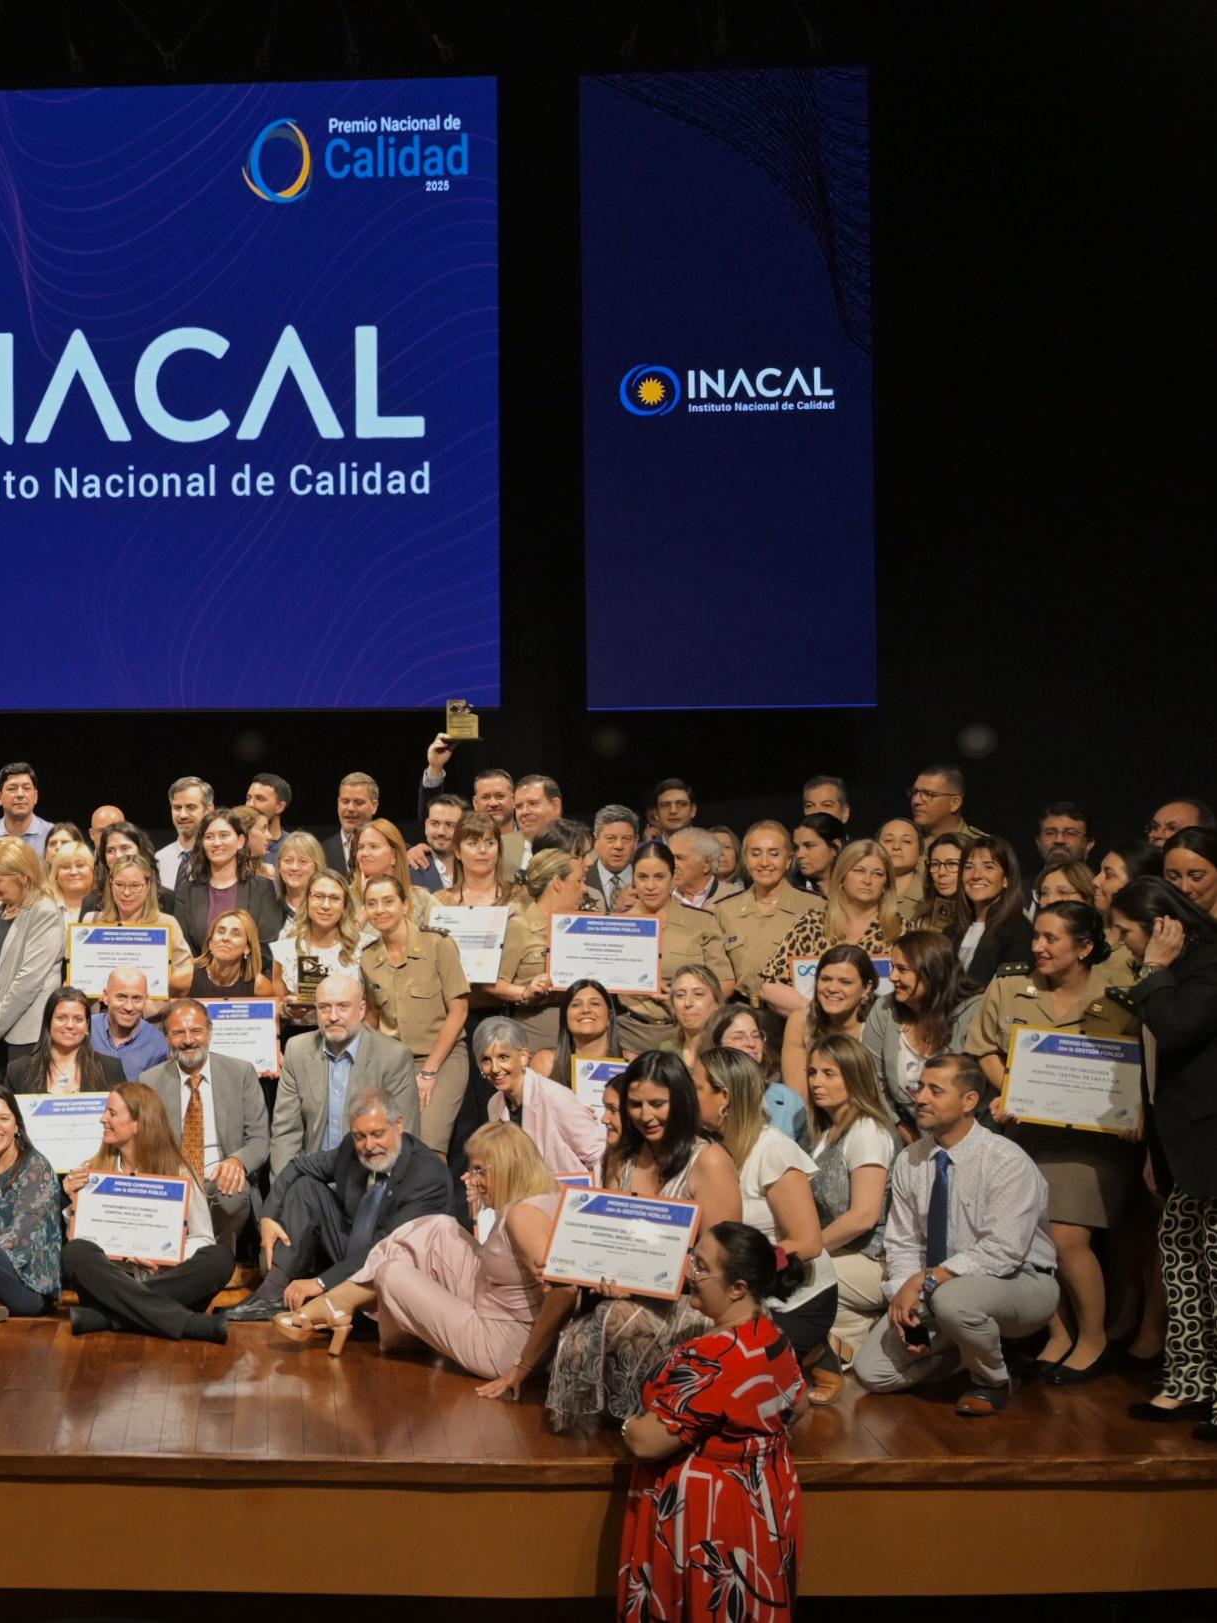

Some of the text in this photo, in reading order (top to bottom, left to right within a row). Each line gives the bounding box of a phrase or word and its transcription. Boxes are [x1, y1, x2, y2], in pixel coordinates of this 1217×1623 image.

[329, 114, 461, 134] Premio Nacional de
[325, 133, 469, 179] Calidad
[426, 180, 450, 191] 2025
[688, 367, 834, 399] INACAL
[688, 400, 835, 412] Instituto Nacional de Calidad
[54, 464, 216, 499] Nacional
[230, 464, 275, 496] de
[290, 461, 431, 496] Calidad
[1074, 1046, 1099, 1055] GESTIÓN
[1099, 1049, 1125, 1057] PÚBLICA
[1081, 1041, 1121, 1050] COMPROMISO
[606, 1199, 669, 1213] PREMIO COMPROMISO
[622, 1207, 645, 1217] GESTIÓN
[646, 1211, 672, 1221] PÚBLICA
